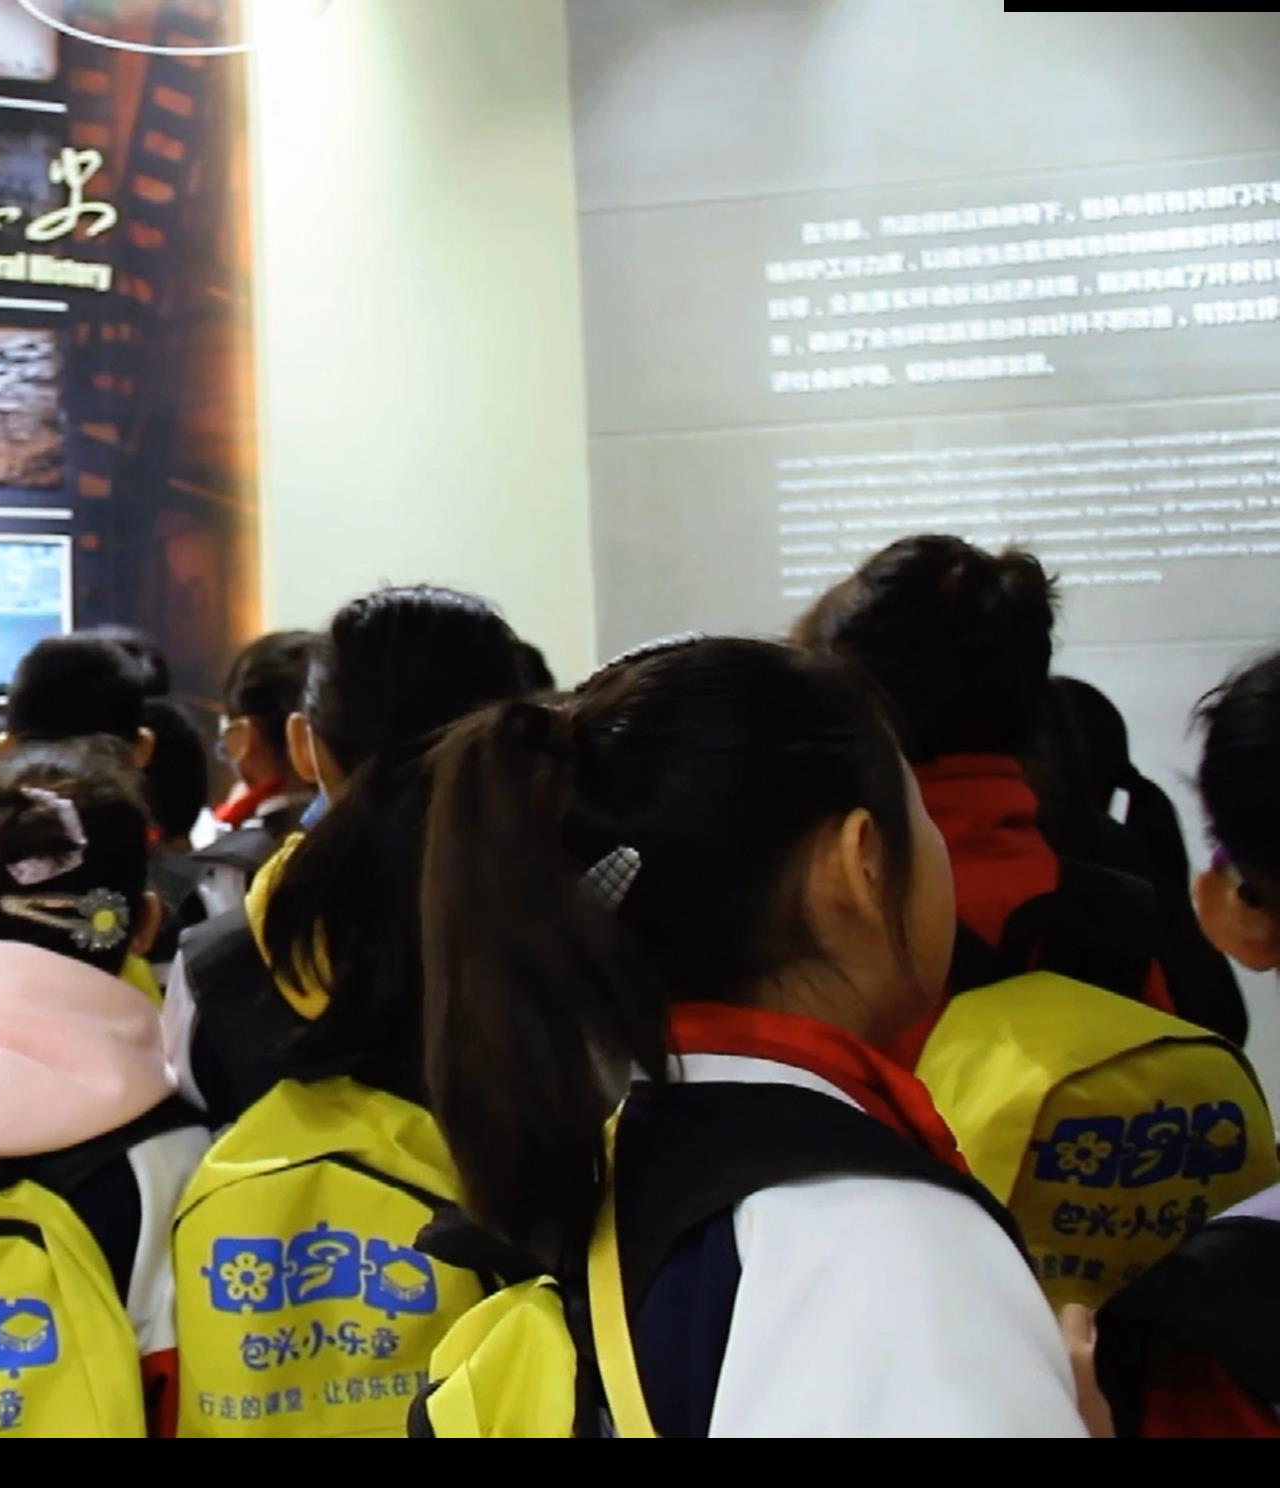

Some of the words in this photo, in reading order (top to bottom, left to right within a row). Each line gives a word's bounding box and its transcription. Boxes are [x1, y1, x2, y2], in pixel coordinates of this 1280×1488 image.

[29, 254, 112, 291] History
[239, 1320, 400, 1372] 包头小乐童
